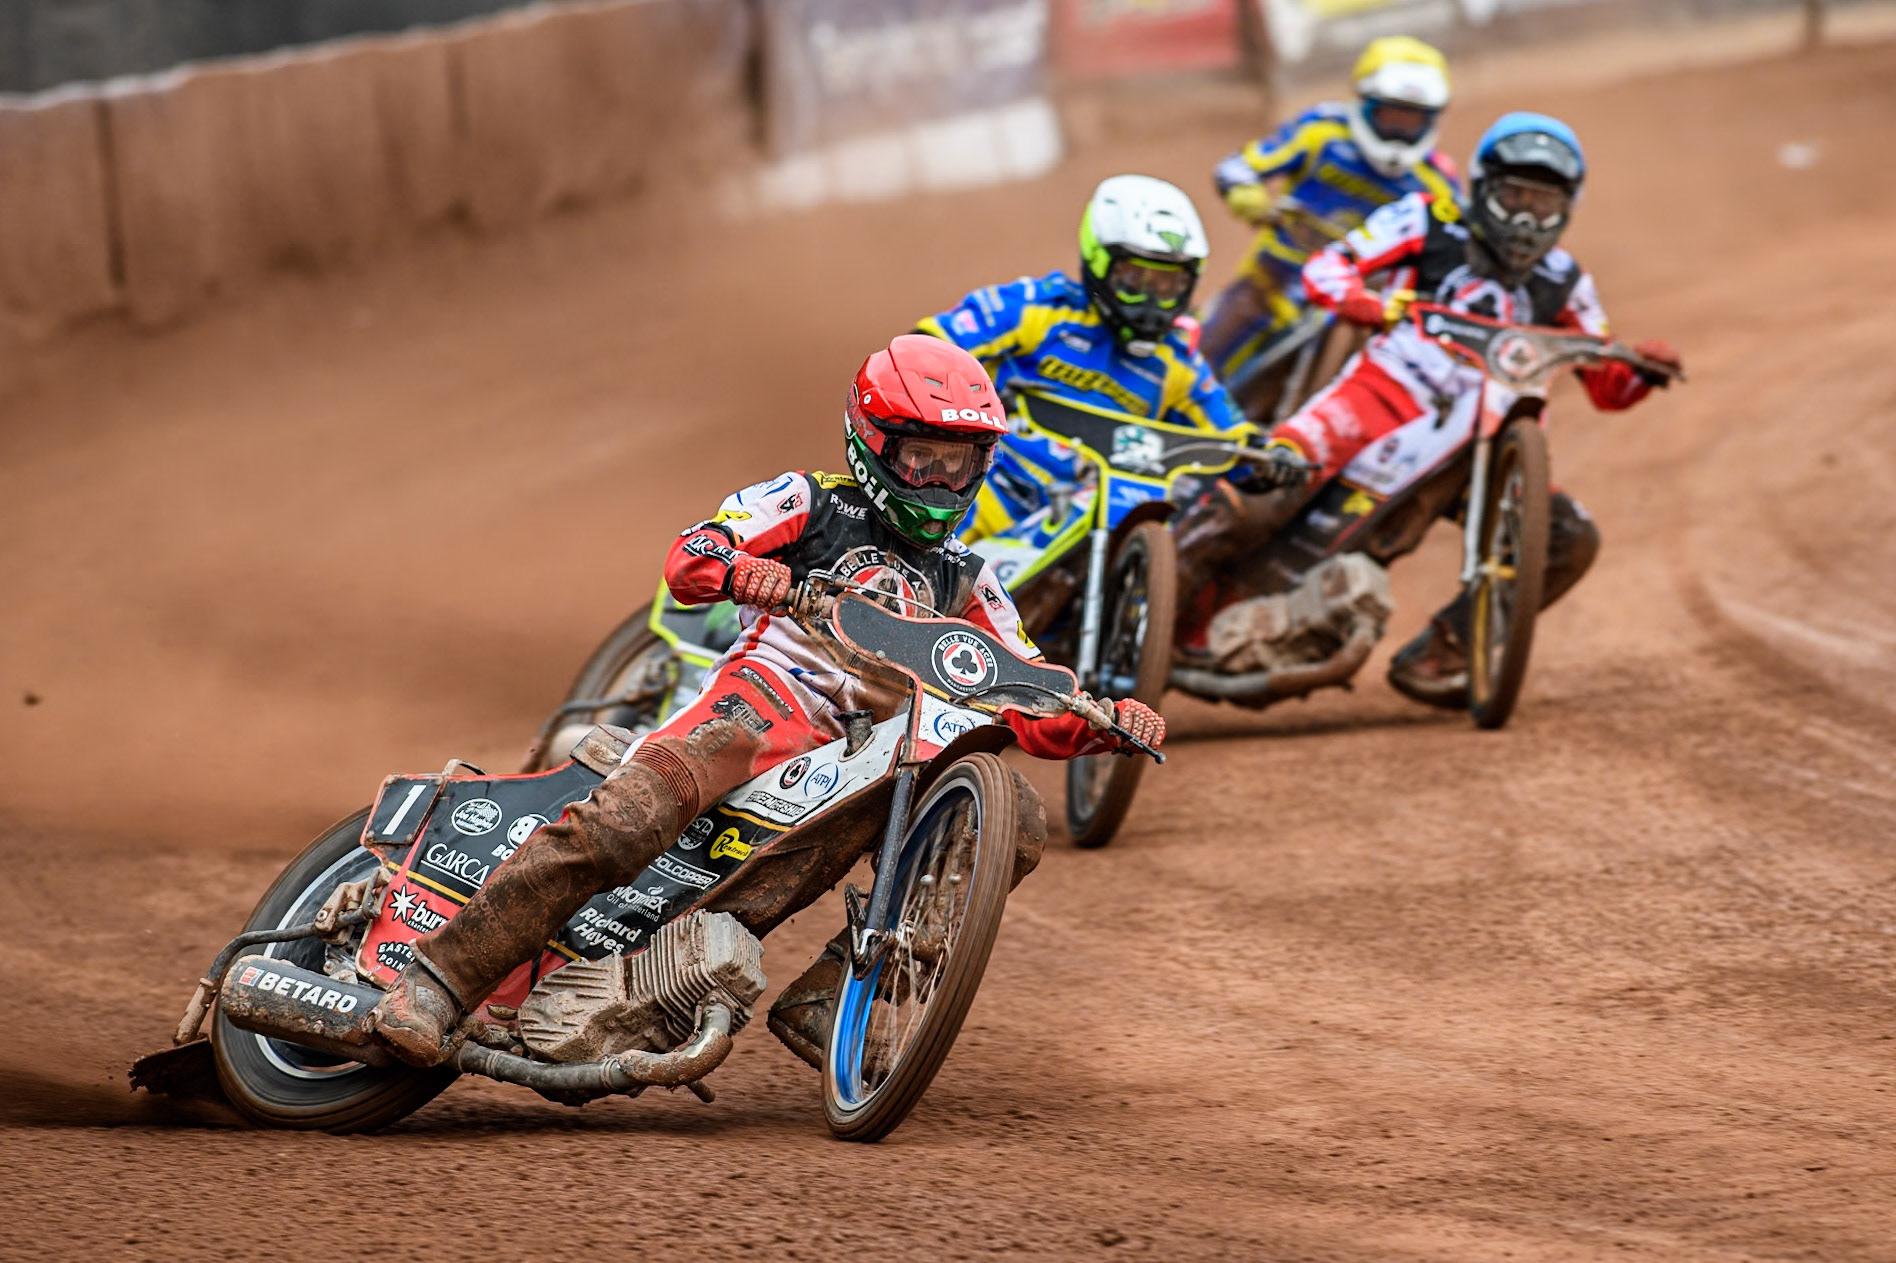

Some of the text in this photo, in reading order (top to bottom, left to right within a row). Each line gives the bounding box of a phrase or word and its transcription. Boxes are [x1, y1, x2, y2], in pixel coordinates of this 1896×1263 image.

[941, 408, 1006, 431] BOLL
[830, 493, 868, 517] ROWE
[839, 553, 880, 577] BELLE
[938, 635, 994, 668] BELLE VUE ACES
[941, 721, 970, 734] ATP
[810, 773, 832, 789] ATPI
[382, 784, 427, 836] 1
[655, 856, 713, 886] OLCOPPER
[606, 893, 619, 904] Oil
[573, 923, 625, 954] Hayes
